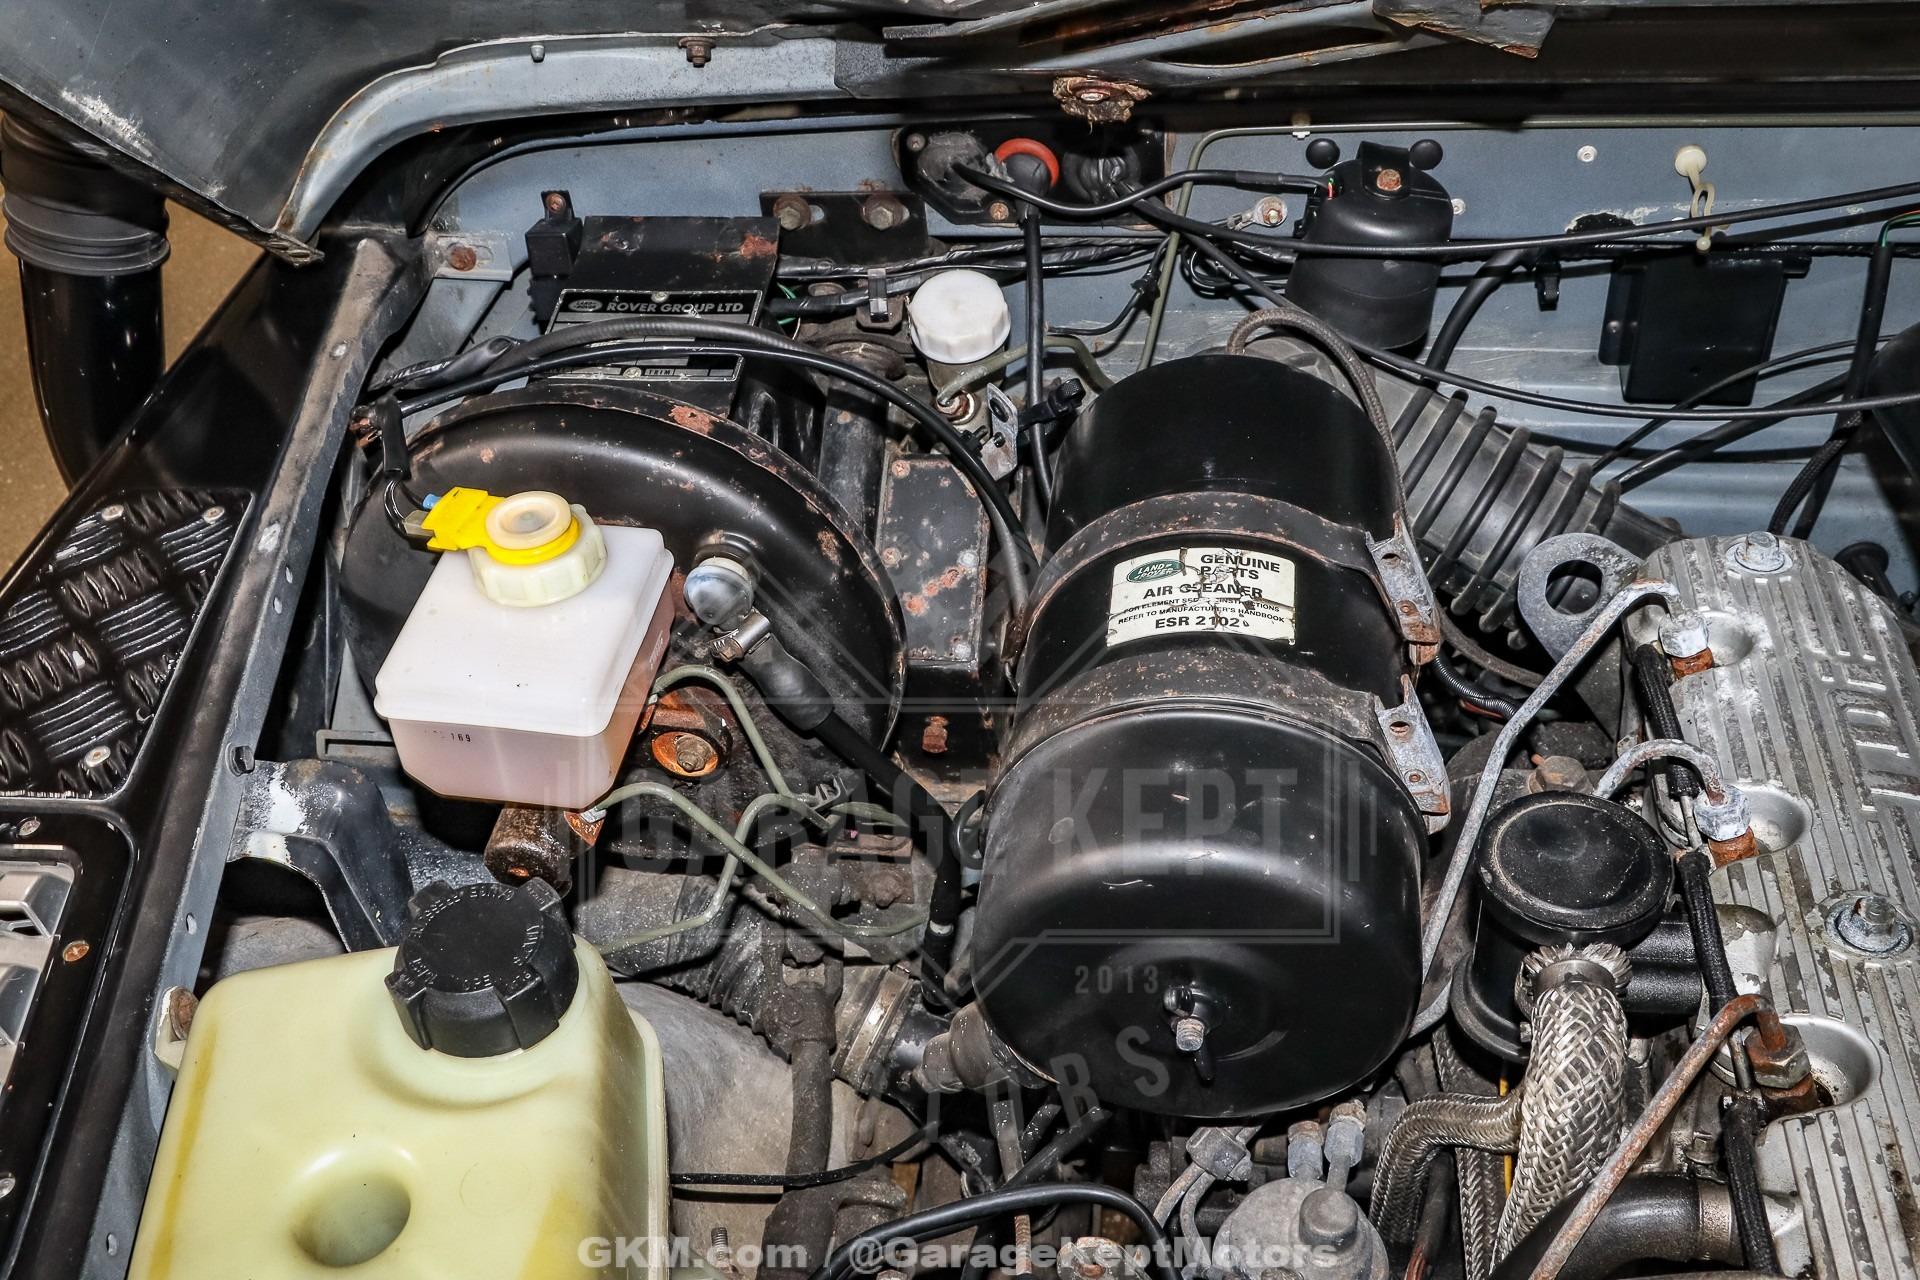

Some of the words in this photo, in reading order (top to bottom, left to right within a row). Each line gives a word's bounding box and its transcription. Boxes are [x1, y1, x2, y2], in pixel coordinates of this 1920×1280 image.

[605, 302, 658, 312] ROVER
[659, 303, 714, 313] GROUP
[717, 303, 744, 313] LTD
[1138, 564, 1165, 574] LAND
[1200, 554, 1280, 573] GENUINE
[1139, 568, 1174, 580] ROVER
[1143, 585, 1173, 599] AIR
[1141, 599, 1180, 609] ELEMENT
[1118, 614, 1144, 624] REFER
[1238, 608, 1285, 623] HANDBOOK
[1155, 616, 1190, 629] ESR
